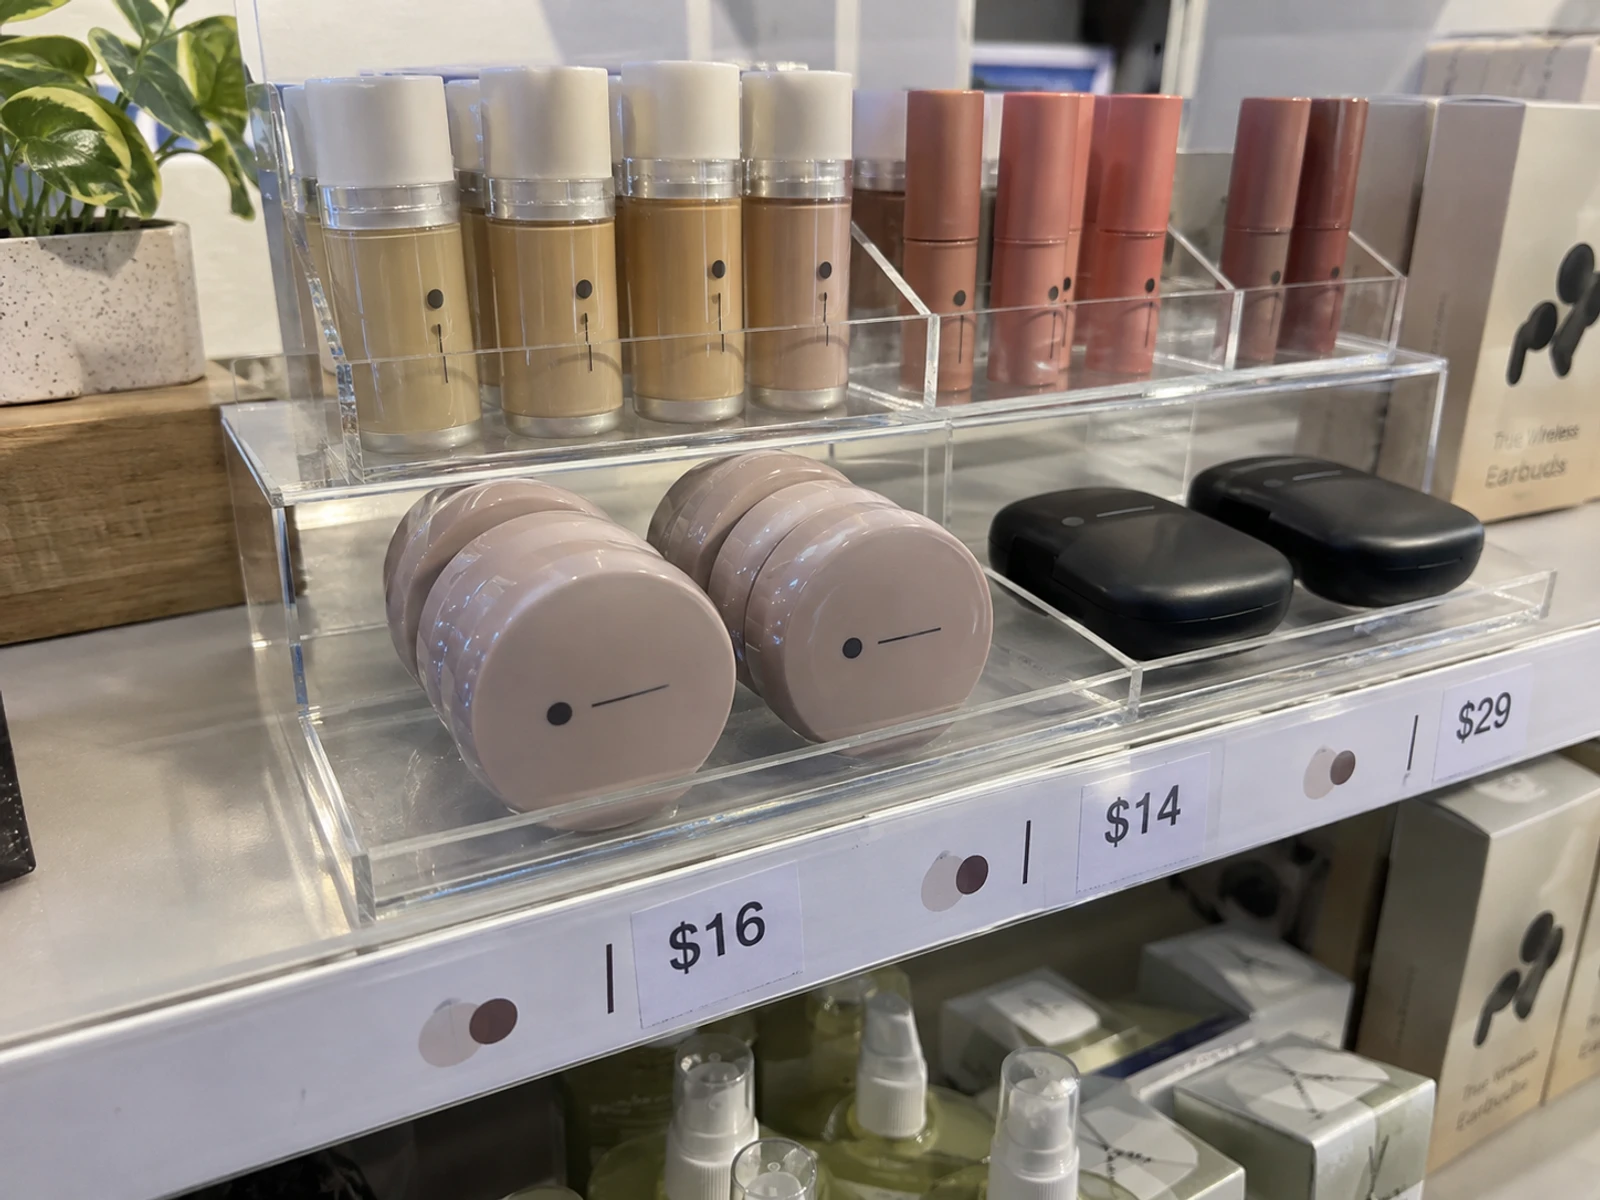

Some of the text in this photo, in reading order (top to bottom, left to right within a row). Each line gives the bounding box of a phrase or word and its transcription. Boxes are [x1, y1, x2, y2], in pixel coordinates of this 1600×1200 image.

[1484, 454, 1567, 488] Earbuds
[1456, 691, 1512, 743] $29
[1104, 784, 1181, 848] $14
[669, 901, 766, 975] $16
